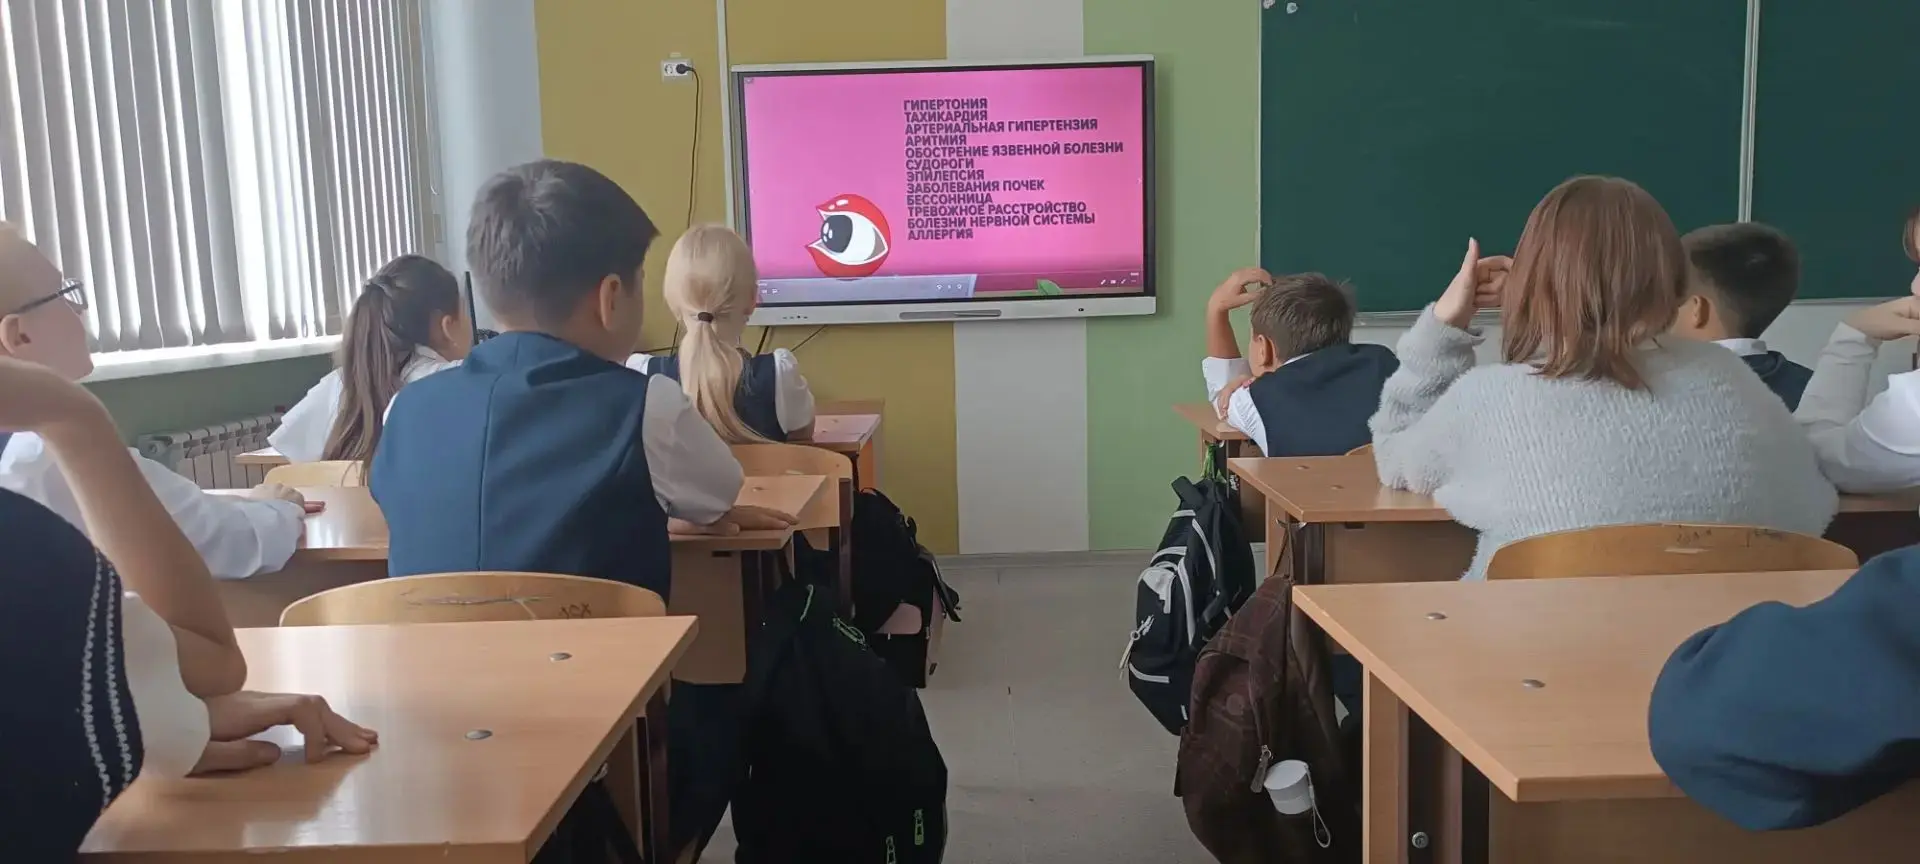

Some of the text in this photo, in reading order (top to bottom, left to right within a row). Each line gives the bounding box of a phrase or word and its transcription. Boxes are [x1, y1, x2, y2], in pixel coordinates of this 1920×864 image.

[904, 98, 987, 111] ГИПЕРТОНИЯ
[904, 111, 987, 123] ТАХИКАРДИЯ
[905, 119, 1098, 134] АРТЕРИАЛЬНАЯ ГИПЕРТЕНЗИЯ
[905, 135, 966, 146] АРИТМИЯ
[905, 142, 1123, 158] ОБОСТРЕНИЕ ЯЗВЕННОЙ БОЛЕЗНИ
[906, 158, 974, 170] СУДОРОГИ
[907, 170, 984, 182] ЭПИЛЕПСИЯ
[907, 180, 1045, 193] ЗАБОЛЕВАНИЯ ПОЧЕК
[907, 193, 992, 206] БЕССОННИЦА
[908, 202, 1086, 217] ТРЕВОЖНОЕ РАССТРОЙСТВО
[908, 213, 1095, 229] БОЛЕЗНИ НЕРВНОЙ СИСТЕМЫ
[908, 229, 973, 240] АЛЛЕРГИЯ
